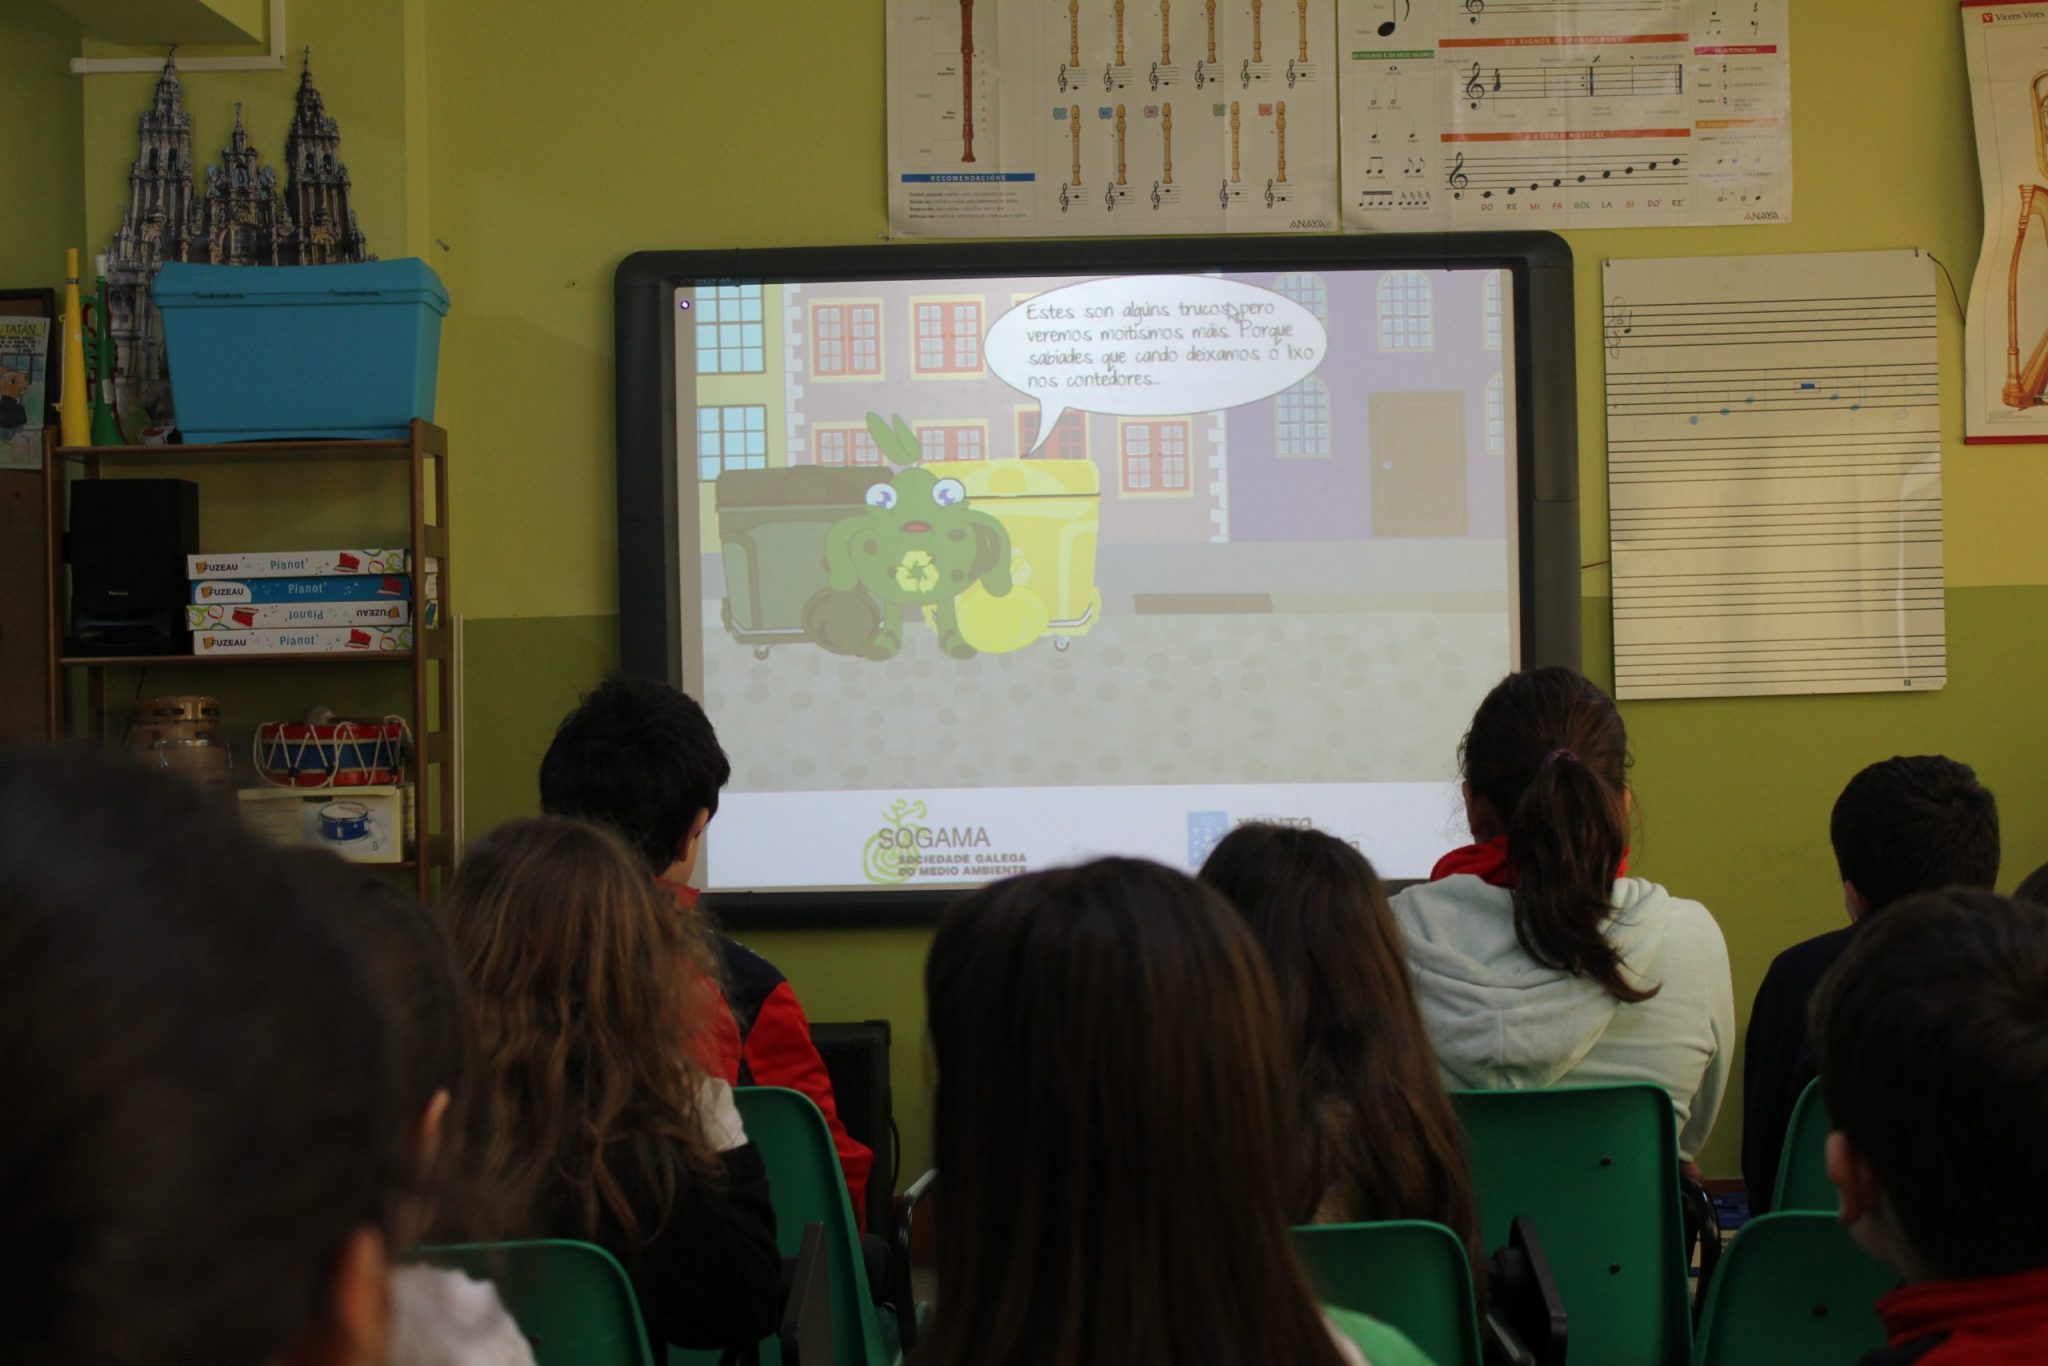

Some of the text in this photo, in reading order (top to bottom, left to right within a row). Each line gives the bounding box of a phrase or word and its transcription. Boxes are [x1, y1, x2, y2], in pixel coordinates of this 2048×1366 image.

[930, 174, 1007, 183] RECOMENDACIÓNS
[1481, 203, 1494, 212] DO
[1506, 203, 1519, 211] RE
[1552, 202, 1564, 210] FA
[1574, 201, 1592, 210] SOL
[1601, 201, 1613, 209] LA
[1626, 200, 1635, 208] SI
[1744, 211, 1779, 221] ANAYA
[1289, 219, 1326, 229] ANAYA
[1026, 303, 1075, 320] Estes
[1084, 305, 1115, 319] son
[1240, 303, 1275, 320] pero
[1026, 329, 1093, 342] veremos
[1240, 319, 1294, 346] Porque
[1101, 350, 1127, 372] que
[1136, 345, 1178, 363] cando
[1186, 344, 1261, 362] deixamos
[1027, 375, 1059, 388] nos
[203, 563, 239, 572] FUZEAU
[209, 588, 244, 597] FUZEAU
[356, 608, 392, 618] FUZEAU
[212, 639, 247, 648] FUZEAU
[878, 827, 991, 850] SOGAMA
[898, 852, 1028, 865] SOCIEDADE GALEGA
[898, 864, 1028, 877] DO MEDIO AMBIENTE
